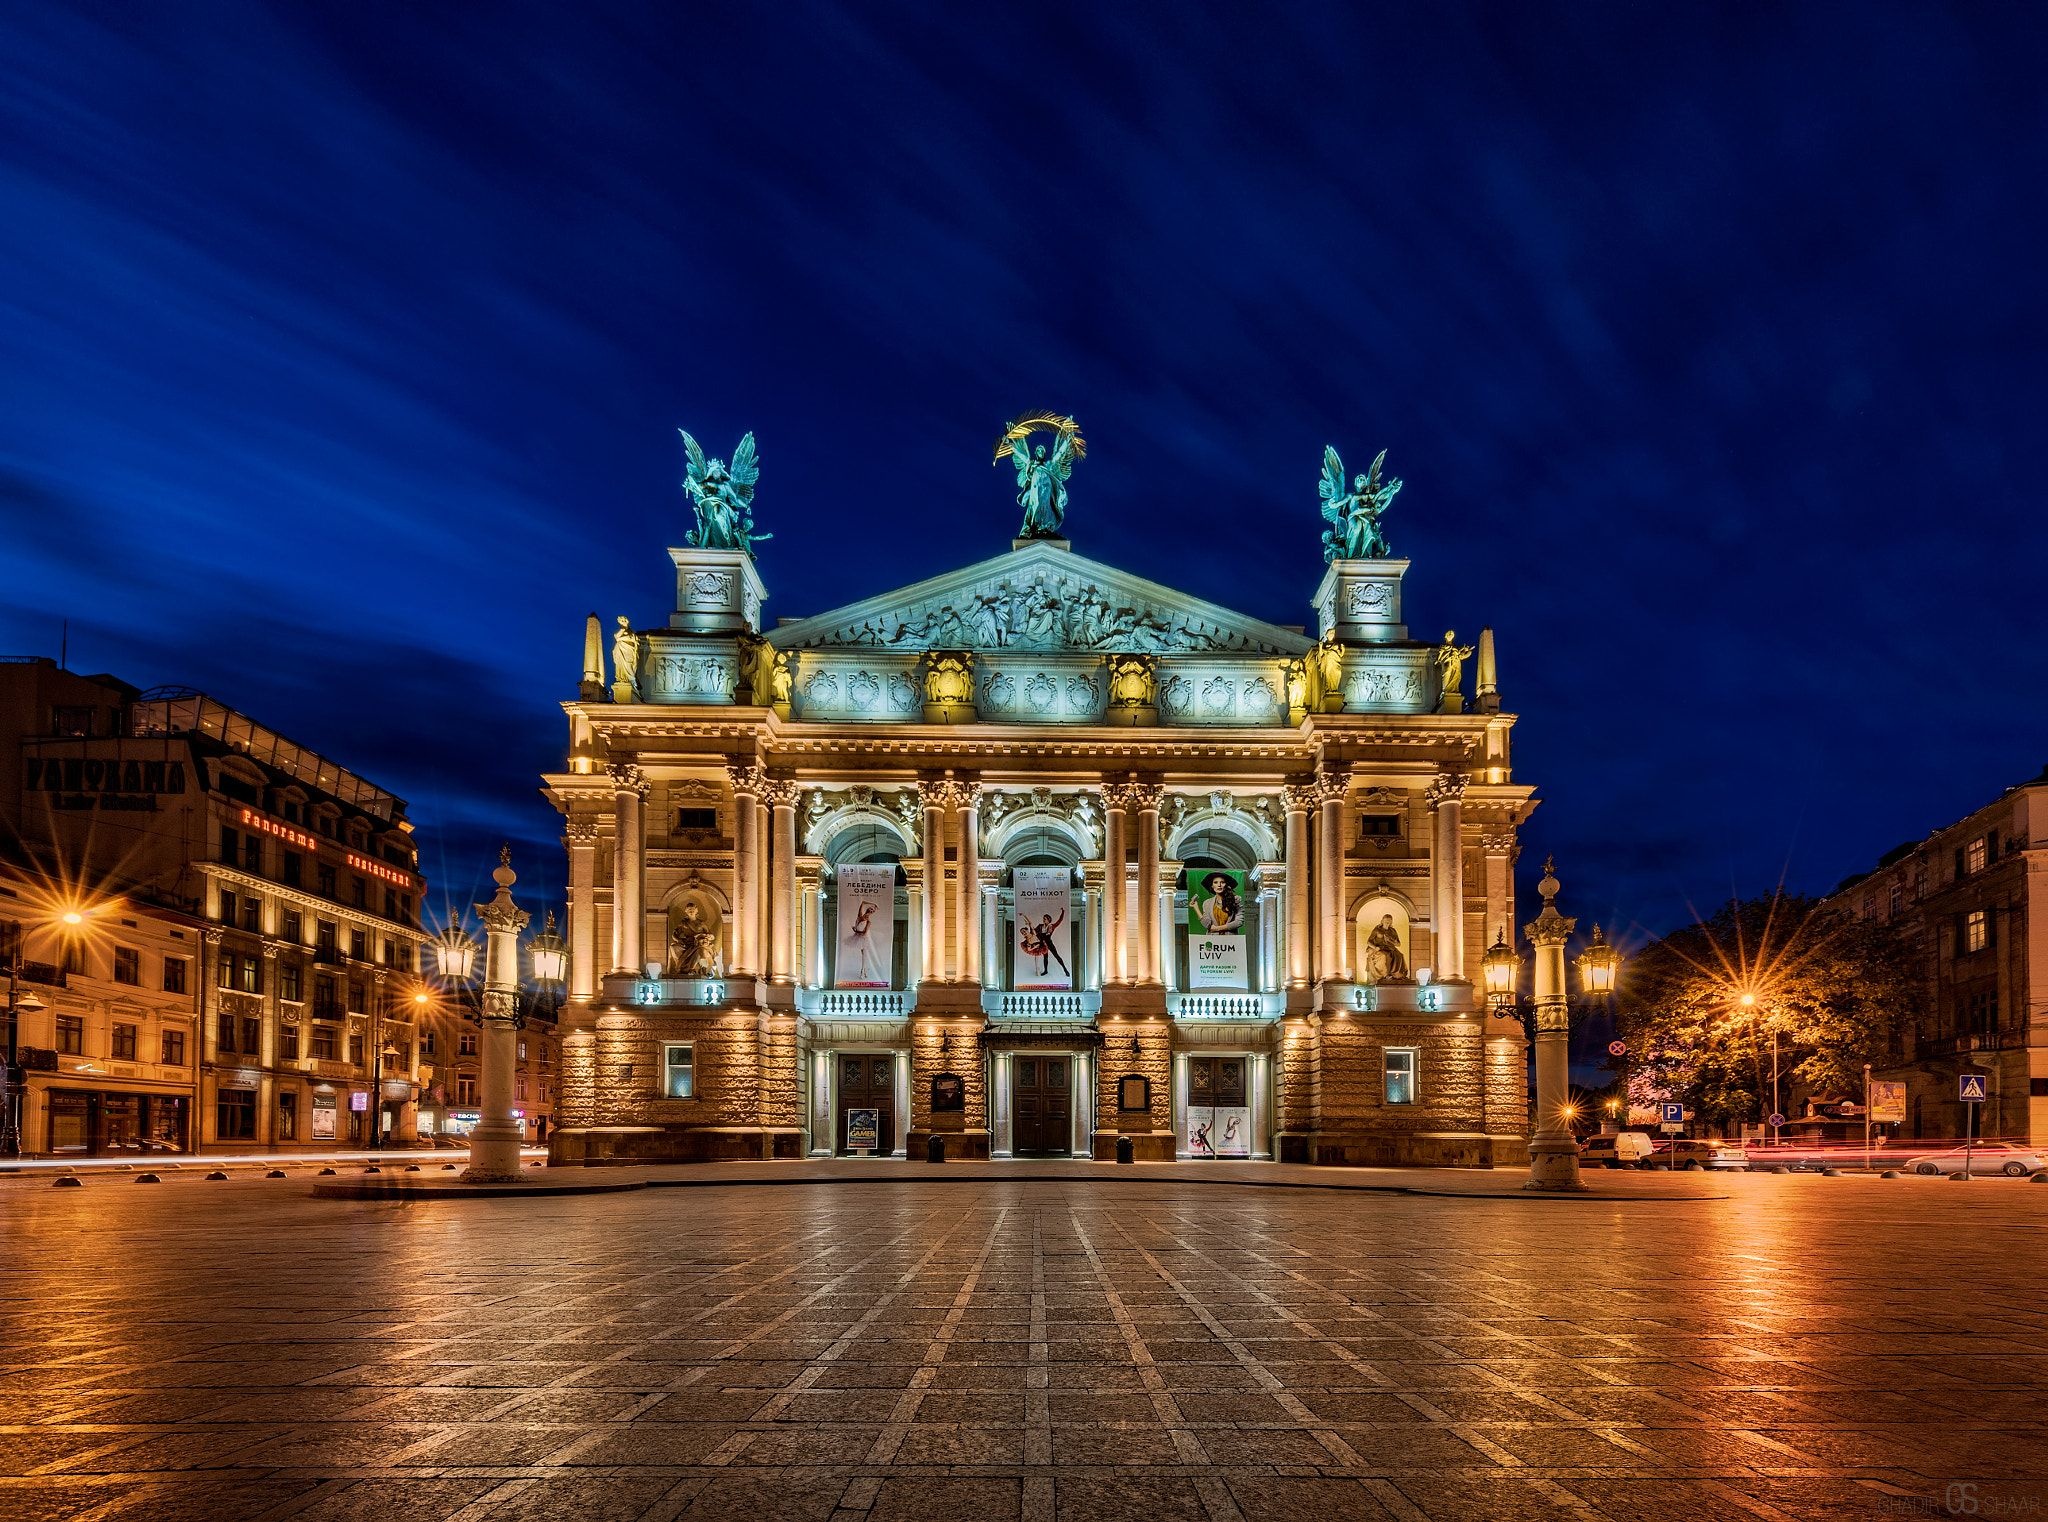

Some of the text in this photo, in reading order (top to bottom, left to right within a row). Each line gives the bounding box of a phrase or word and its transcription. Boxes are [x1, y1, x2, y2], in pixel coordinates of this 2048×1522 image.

[242, 809, 410, 887] Panorama restaurant
[1199, 941, 1236, 952] FORUM
[1199, 952, 1222, 960] LVIV
[1667, 1106, 1678, 1119] P
